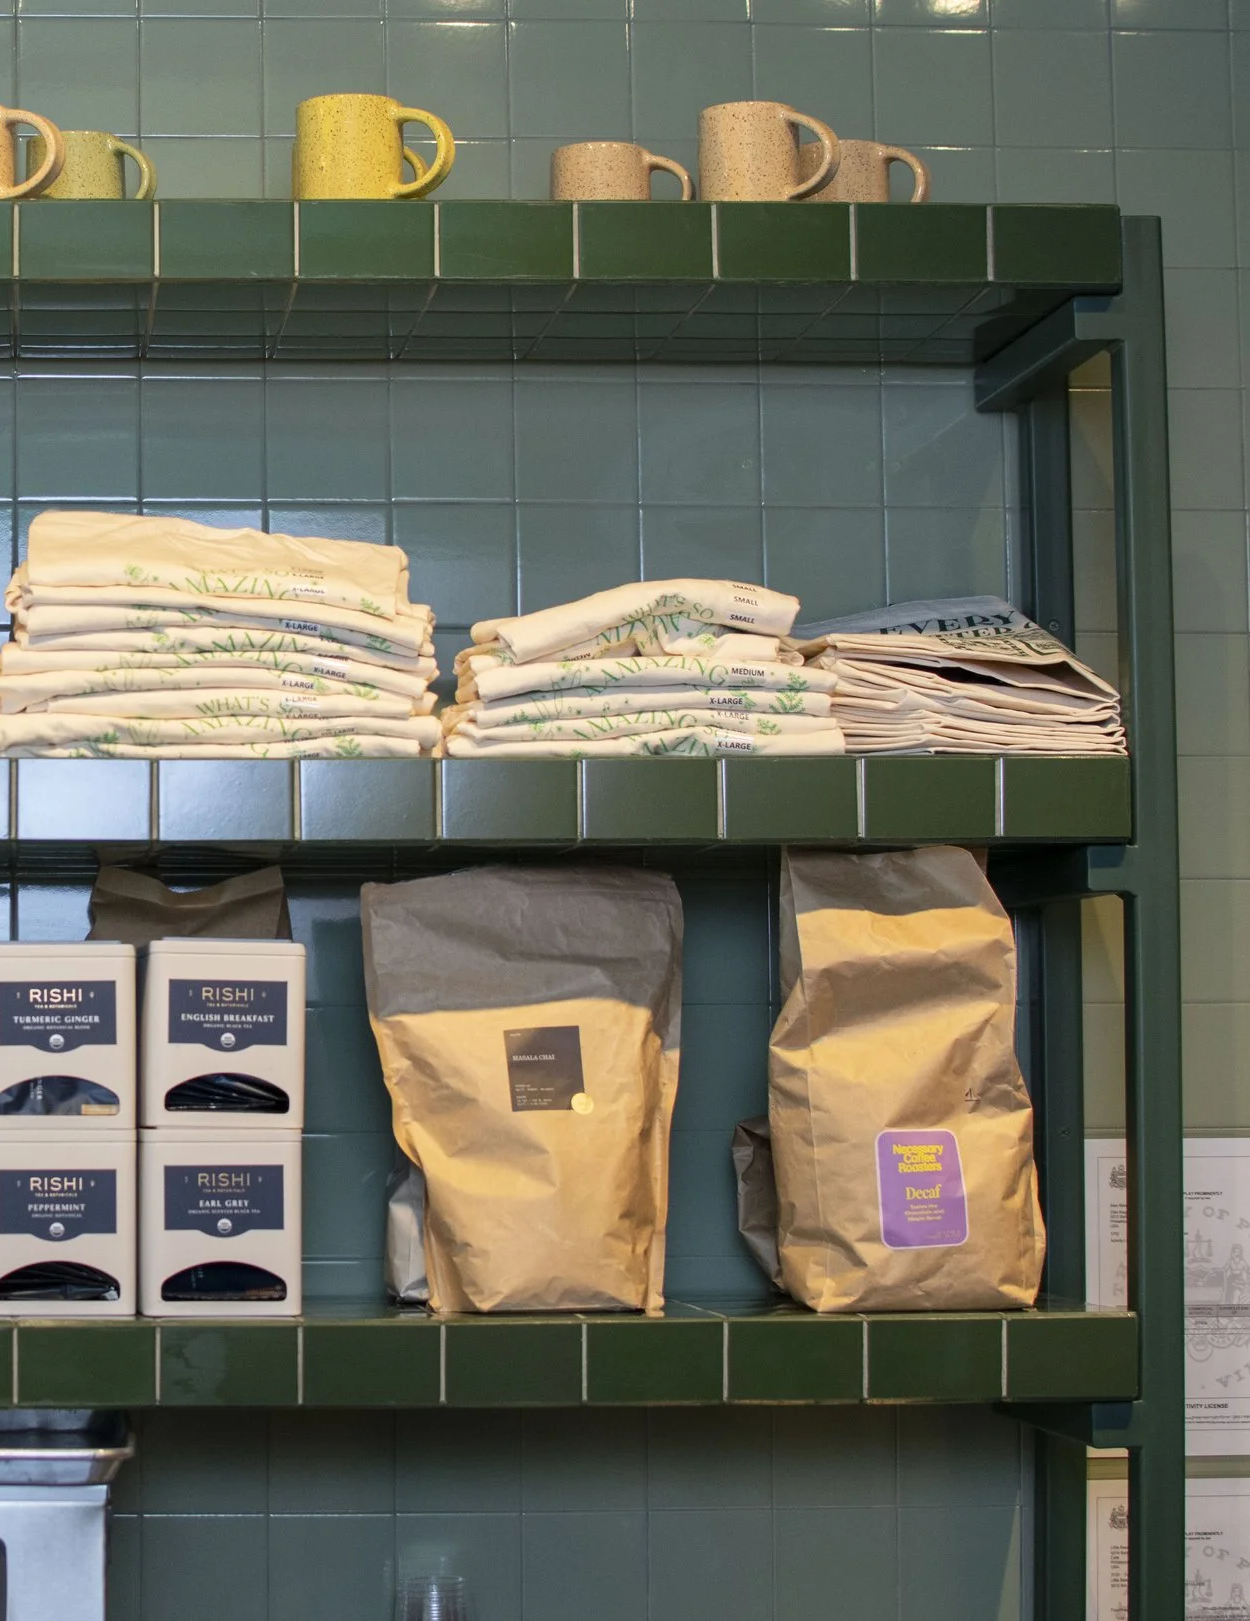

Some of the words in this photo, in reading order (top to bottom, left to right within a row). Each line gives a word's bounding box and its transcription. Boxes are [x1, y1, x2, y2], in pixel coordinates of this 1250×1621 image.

[733, 596, 759, 607] SMALL
[729, 613, 755, 624] SMALL
[284, 622, 318, 631] X-LARGE
[313, 667, 346, 679] X-LARGE
[731, 667, 765, 677] MEDIUM
[282, 680, 315, 689] X-LARGE
[709, 697, 743, 705] X-LARGE
[717, 741, 751, 750] X-LARGE
[29, 988, 82, 1002] RISHI
[201, 986, 254, 1001] RISHI
[12, 1015, 61, 1024] TURMERIC
[64, 1015, 100, 1023] GINGER
[180, 1013, 221, 1022] ENGLISH
[223, 1014, 275, 1022] BREAKFAST
[893, 1144, 943, 1155] Necessary
[903, 1153, 936, 1163] Coffee
[898, 1162, 942, 1173] Roasters
[29, 1177, 83, 1191] RISHI
[197, 1173, 250, 1187] RISHI
[905, 1184, 942, 1200] Decaf
[199, 1200, 222, 1208] EARL
[225, 1199, 250, 1207] GREY
